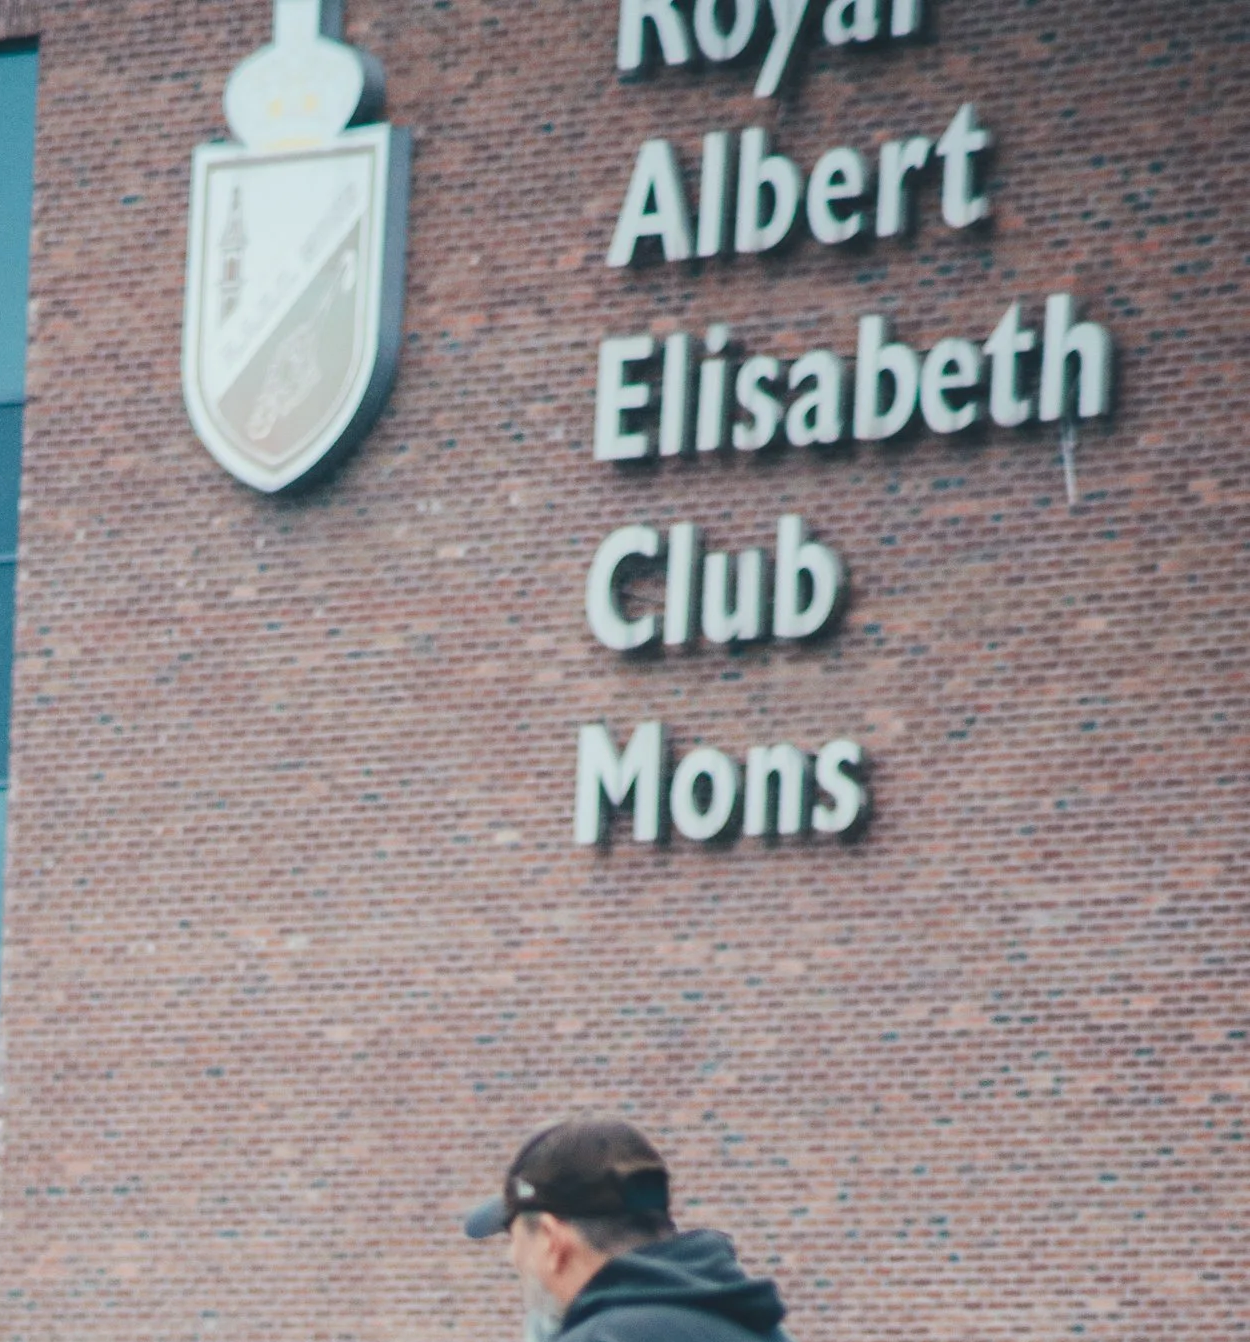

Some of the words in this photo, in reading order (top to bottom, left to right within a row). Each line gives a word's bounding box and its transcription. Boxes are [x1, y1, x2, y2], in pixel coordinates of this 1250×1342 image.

[616, 0, 921, 98] Roya
[607, 102, 991, 267] Albert
[593, 293, 1112, 461] Elisabeth
[585, 514, 845, 650] Club
[574, 720, 866, 845] Mons
